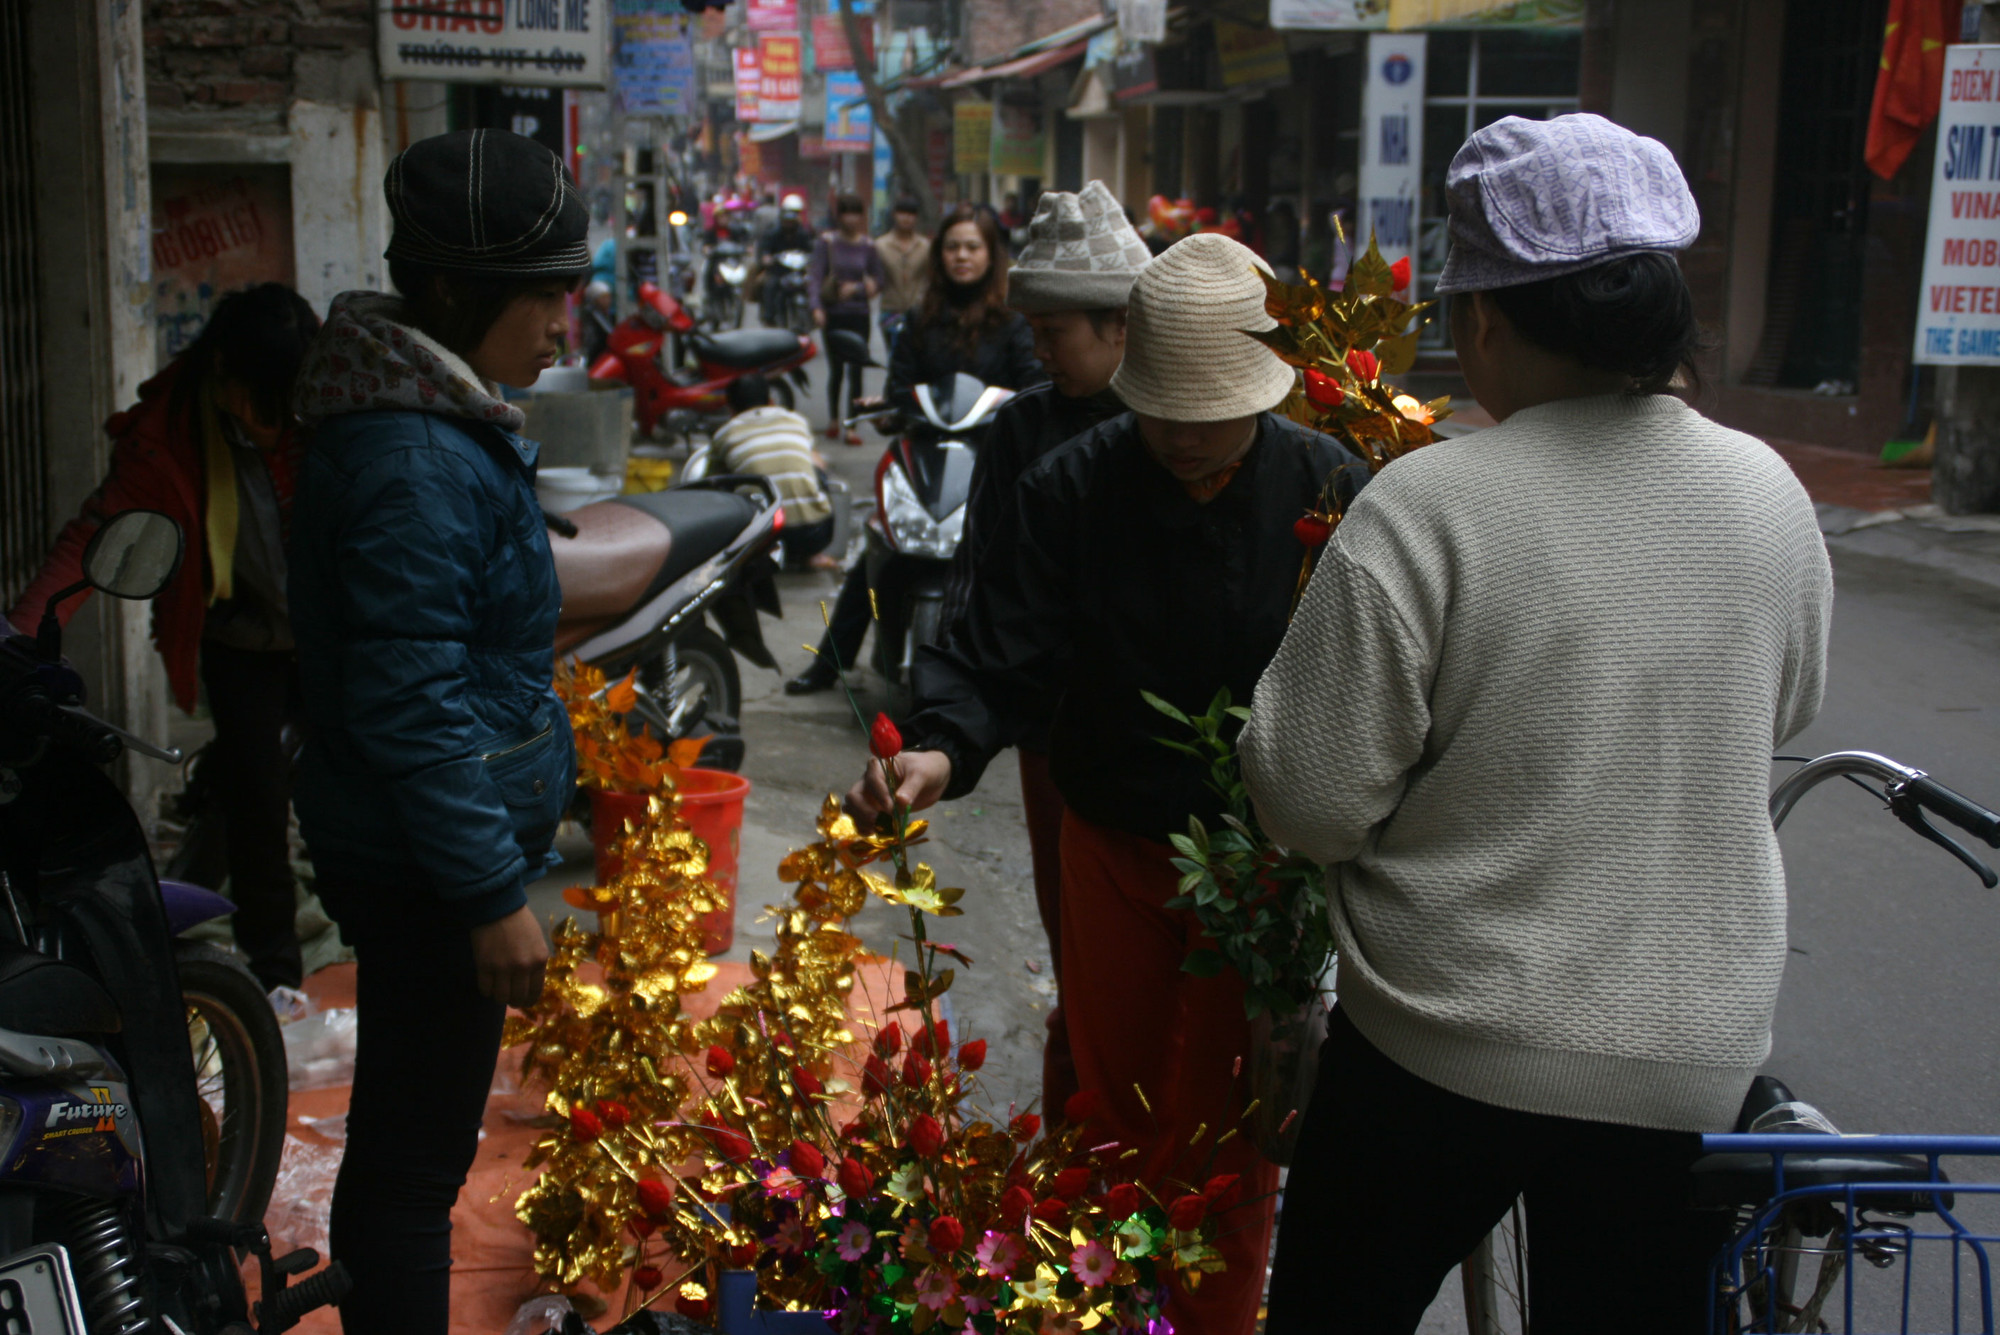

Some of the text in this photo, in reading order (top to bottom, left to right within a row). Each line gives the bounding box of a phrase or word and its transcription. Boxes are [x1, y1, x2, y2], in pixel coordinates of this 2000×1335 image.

[1944, 124, 2000, 181] SIM T
[1942, 237, 2000, 267] MOB
[45, 1101, 128, 1129] Future
[41, 1126, 94, 1141] SMART CRUISER
